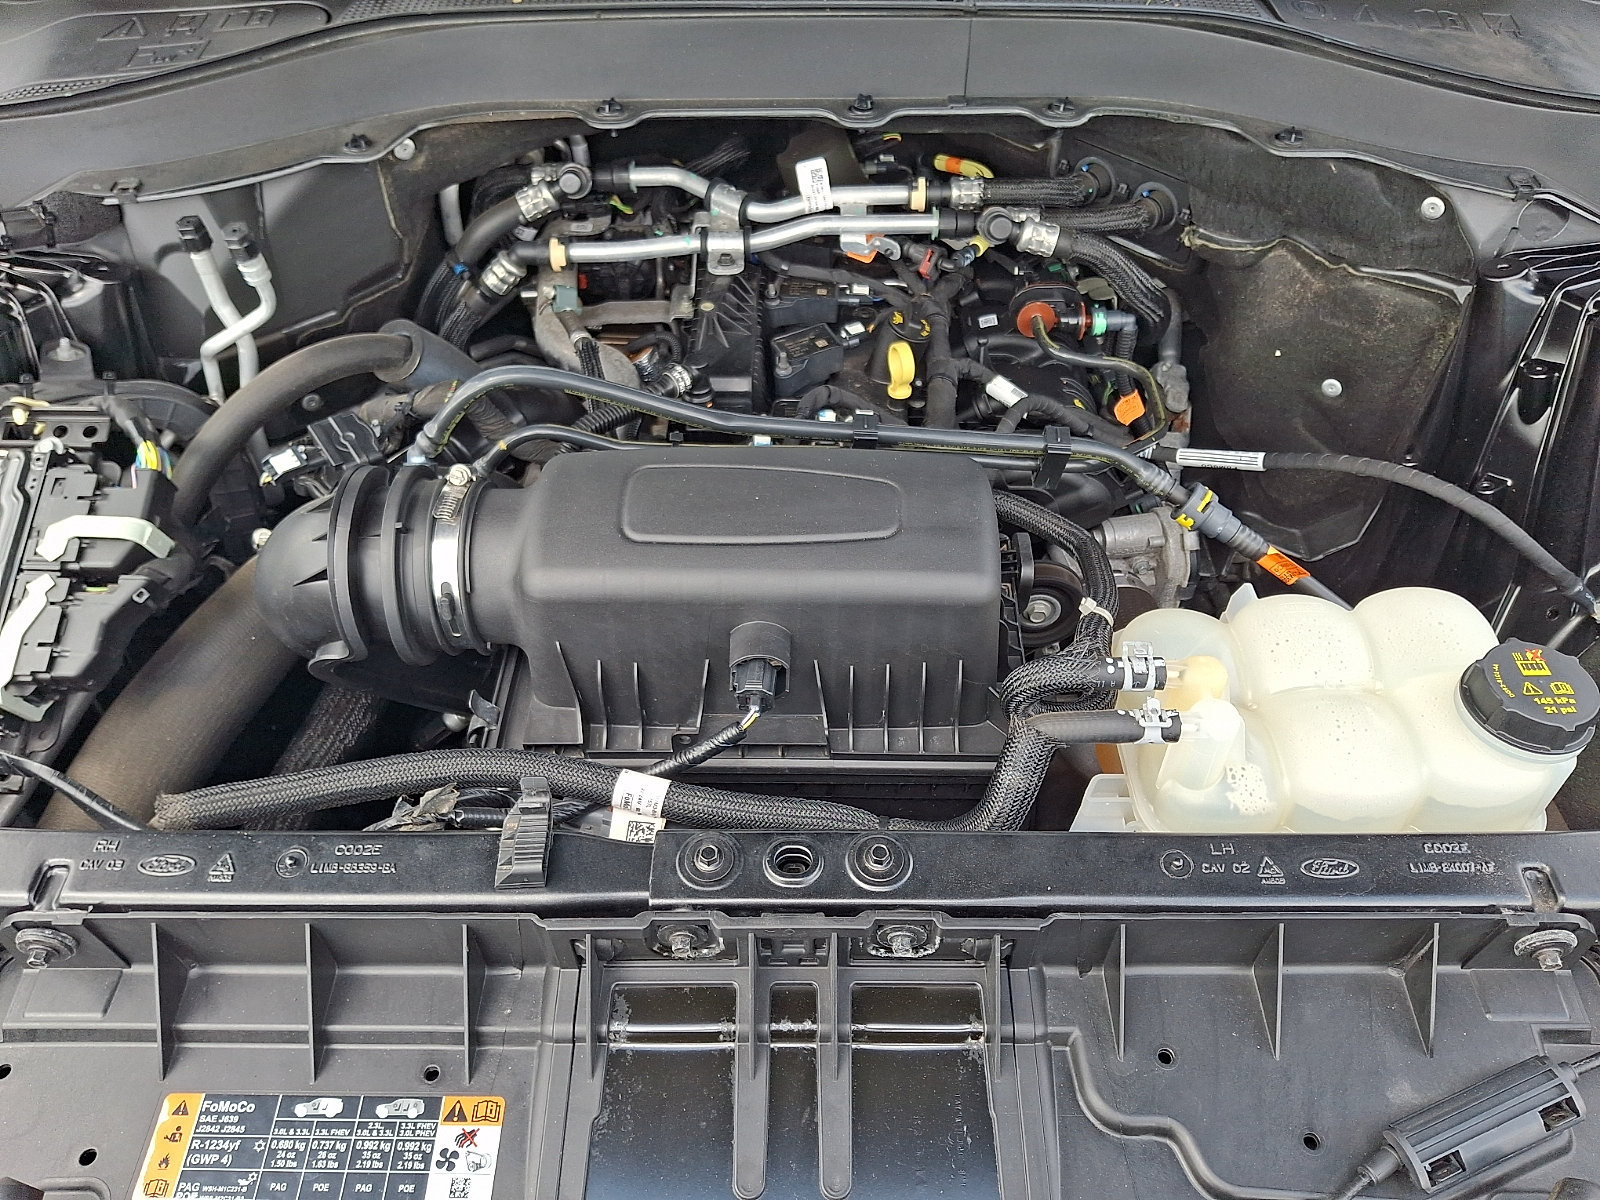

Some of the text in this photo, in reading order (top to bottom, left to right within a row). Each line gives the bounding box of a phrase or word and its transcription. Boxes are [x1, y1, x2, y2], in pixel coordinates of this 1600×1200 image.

[1544, 706, 1577, 714] 21 psi
[93, 839, 121, 852] RH
[1210, 842, 1235, 855] LH
[1202, 863, 1225, 873] CAV
[1232, 862, 1251, 874] 02
[1308, 859, 1353, 877] Ford
[202, 1100, 256, 1112] FoMoCo
[199, 1115, 239, 1123] SAE J639
[191, 1140, 241, 1152] R-1234yf
[271, 1140, 306, 1151] 0.680 kg
[312, 1140, 347, 1152] 0.737 kg
[356, 1141, 391, 1152] 0.992 kg
[397, 1142, 432, 1153] 0.992 kg
[362, 1151, 371, 1159] 35
[403, 1152, 412, 1160] 35
[186, 1154, 233, 1167] (GWP 4)
[286, 1160, 297, 1168] lbs
[327, 1160, 338, 1168] lbs
[356, 1160, 383, 1168] 2.19 lbs
[397, 1161, 425, 1169] 2.19 lbs
[178, 1182, 200, 1192] PAG
[270, 1183, 287, 1191] PAG
[312, 1183, 329, 1192] POE
[355, 1184, 372, 1192] PAG
[398, 1184, 415, 1192] POE
